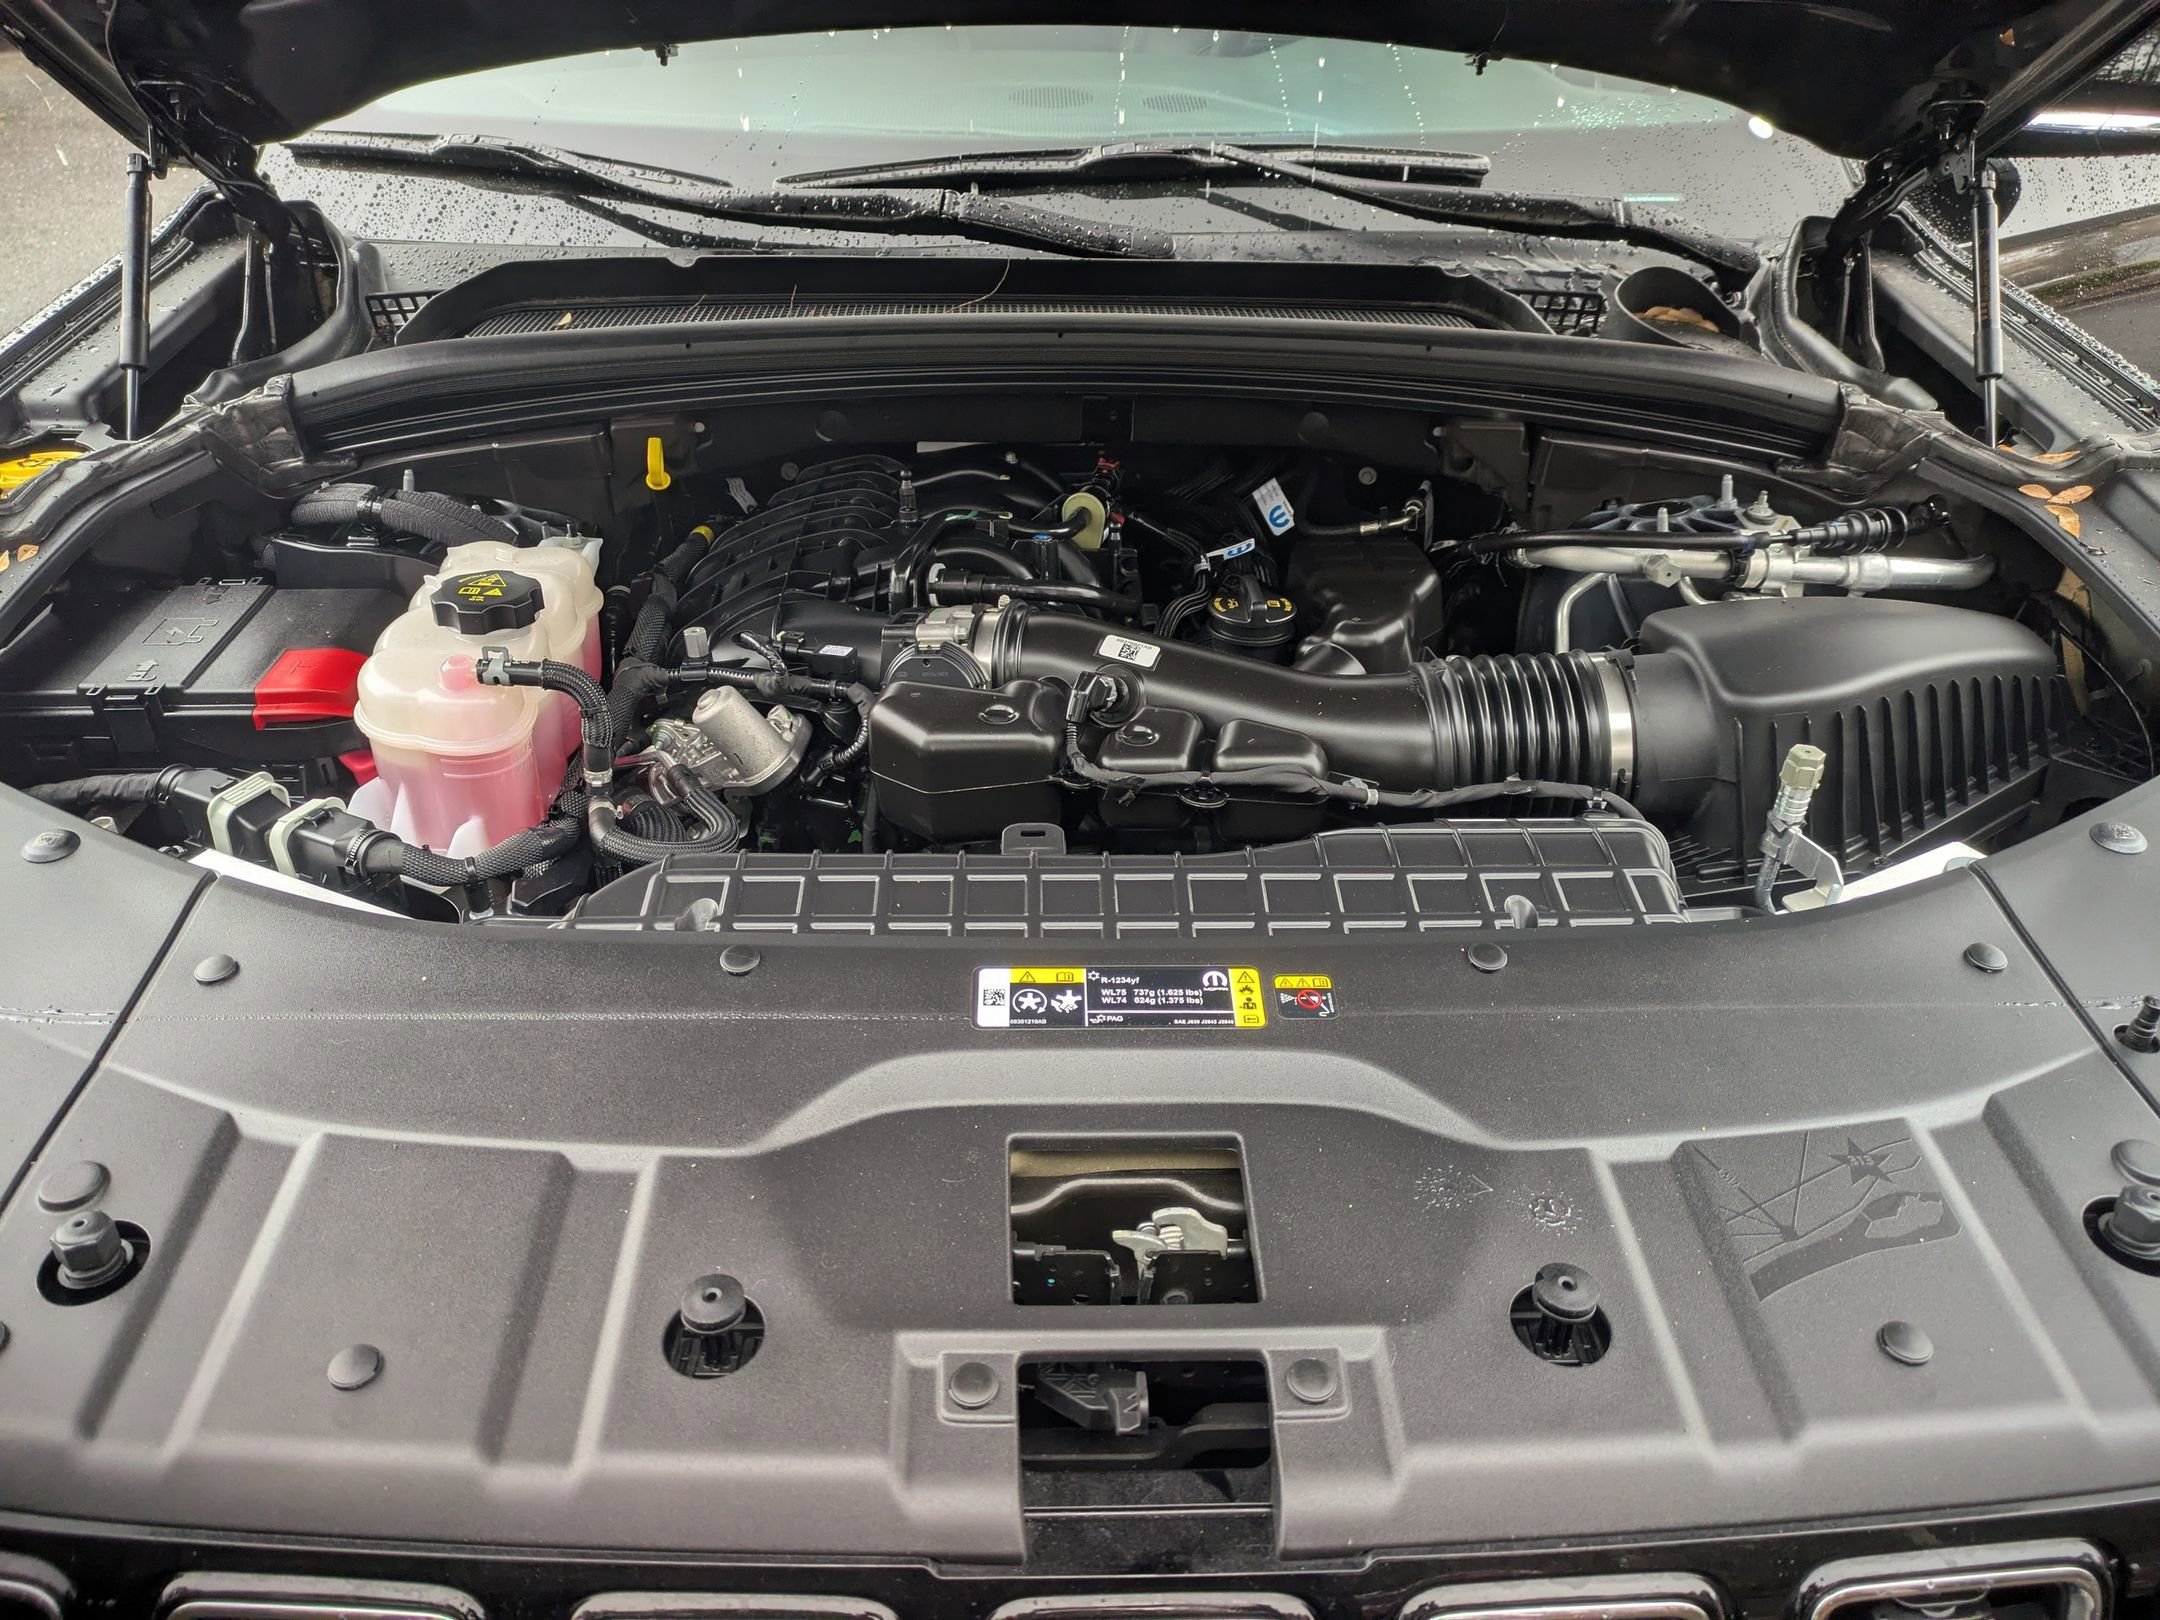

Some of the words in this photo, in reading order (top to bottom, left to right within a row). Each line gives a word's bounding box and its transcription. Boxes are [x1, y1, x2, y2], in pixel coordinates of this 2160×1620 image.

[1101, 976, 1140, 985] R-1234yf
[1101, 988, 1127, 996] WL75
[1133, 988, 1155, 998] 737g
[1157, 988, 1184, 997] (1.625
[1185, 988, 1203, 997] lbs)
[1101, 996, 1128, 1004] WL74
[1134, 996, 1156, 1006] 624g
[1158, 996, 1185, 1006] (1.375
[1186, 996, 1204, 1006] lbs)
[1847, 1154, 1875, 1167] 313
